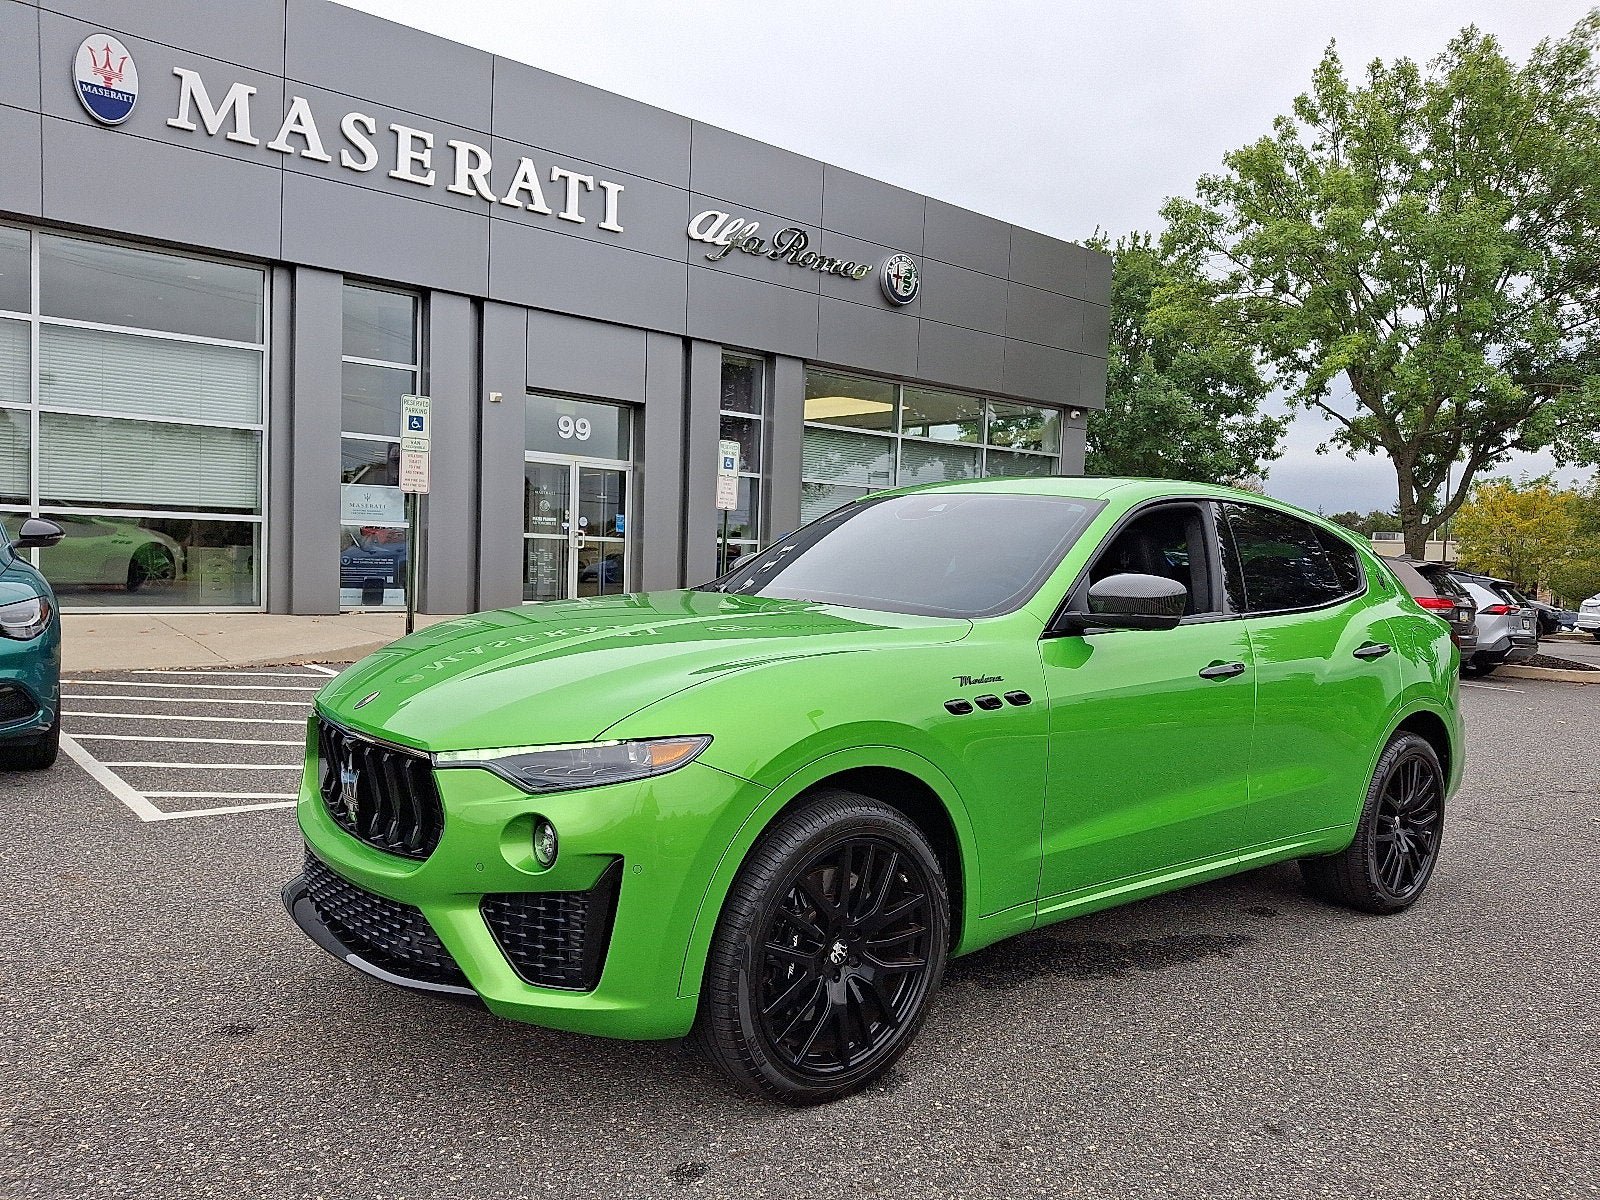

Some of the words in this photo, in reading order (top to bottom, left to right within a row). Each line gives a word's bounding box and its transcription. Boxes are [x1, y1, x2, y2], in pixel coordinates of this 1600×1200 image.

[82, 84, 133, 103] MASERATI
[166, 66, 625, 232] MASERATI
[687, 210, 768, 261] Alfa
[766, 227, 873, 280] Romeo
[403, 399, 429, 408] RESERVED
[404, 406, 428, 415] PARKING
[557, 415, 592, 441] 99
[952, 674, 1004, 687] Modena
